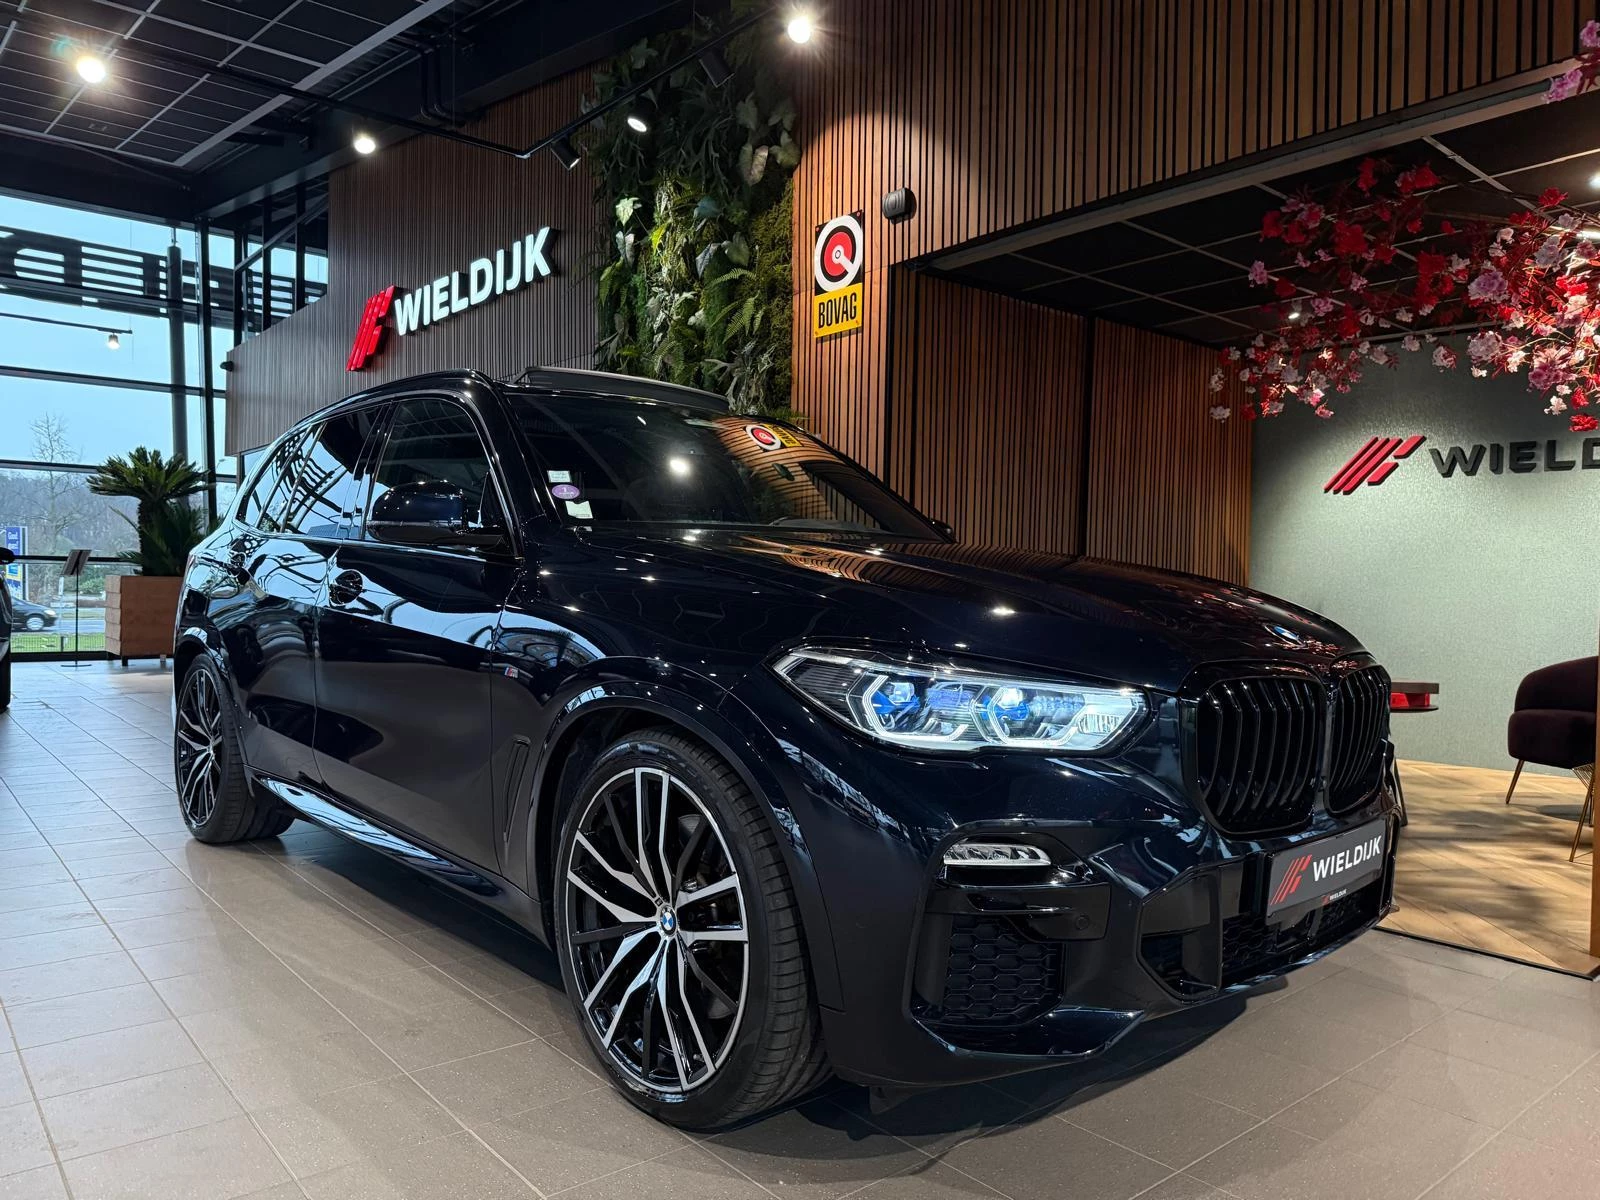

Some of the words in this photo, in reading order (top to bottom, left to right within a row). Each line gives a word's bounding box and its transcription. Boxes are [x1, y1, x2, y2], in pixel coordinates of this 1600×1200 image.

[394, 226, 551, 336] WIELDIJK
[818, 292, 857, 329] BOVAG
[1313, 835, 1382, 882] WIELDIJK
